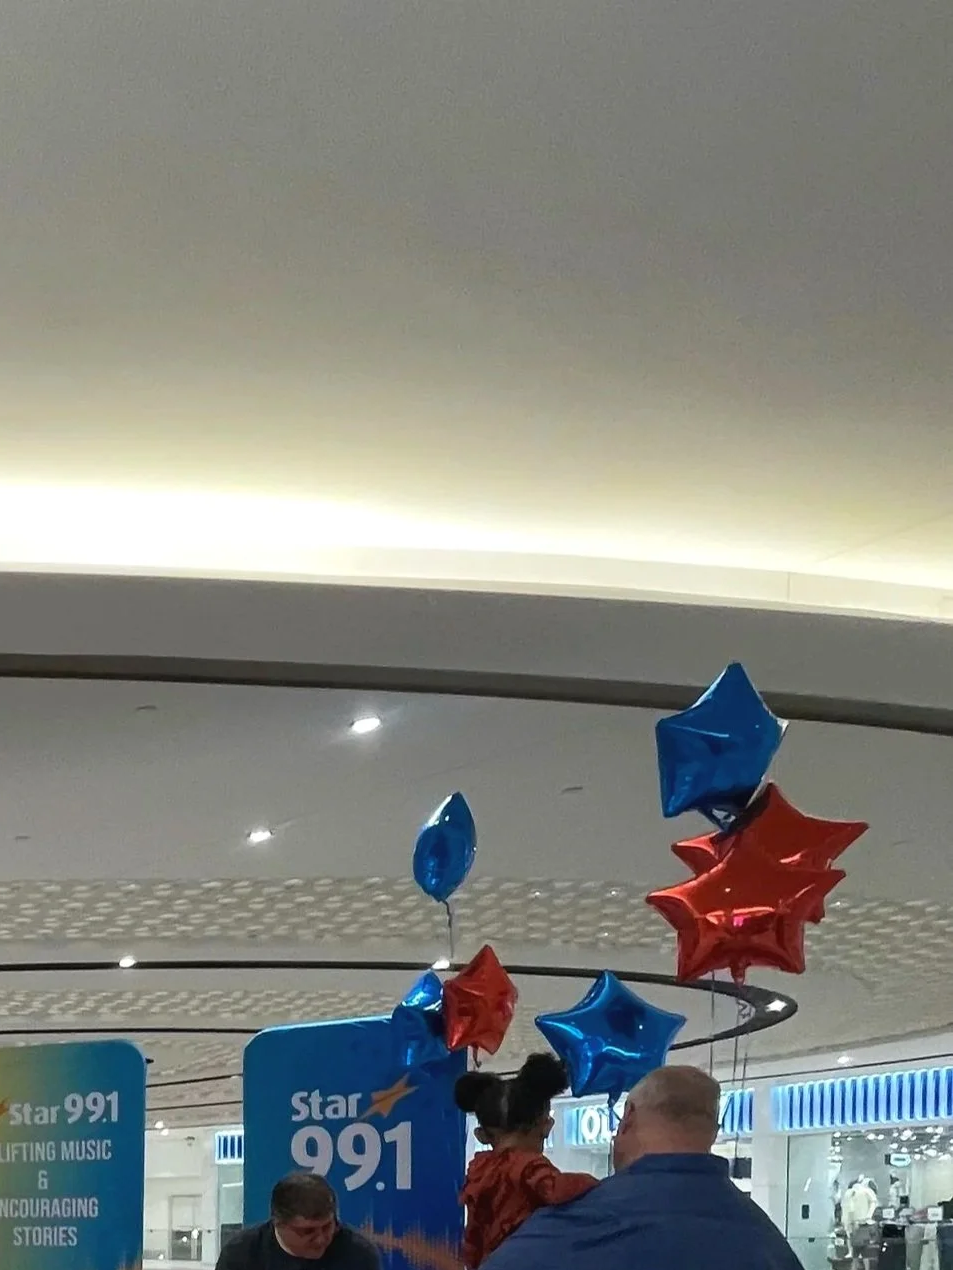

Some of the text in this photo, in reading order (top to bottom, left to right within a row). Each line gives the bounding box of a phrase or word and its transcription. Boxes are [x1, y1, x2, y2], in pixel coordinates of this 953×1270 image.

[9, 1091, 118, 1126] Star 99.1
[291, 1089, 362, 1121] Star
[61, 1139, 112, 1162] MUSIC
[291, 1121, 412, 1191] 99.1
[13, 1225, 78, 1246] STORIES
